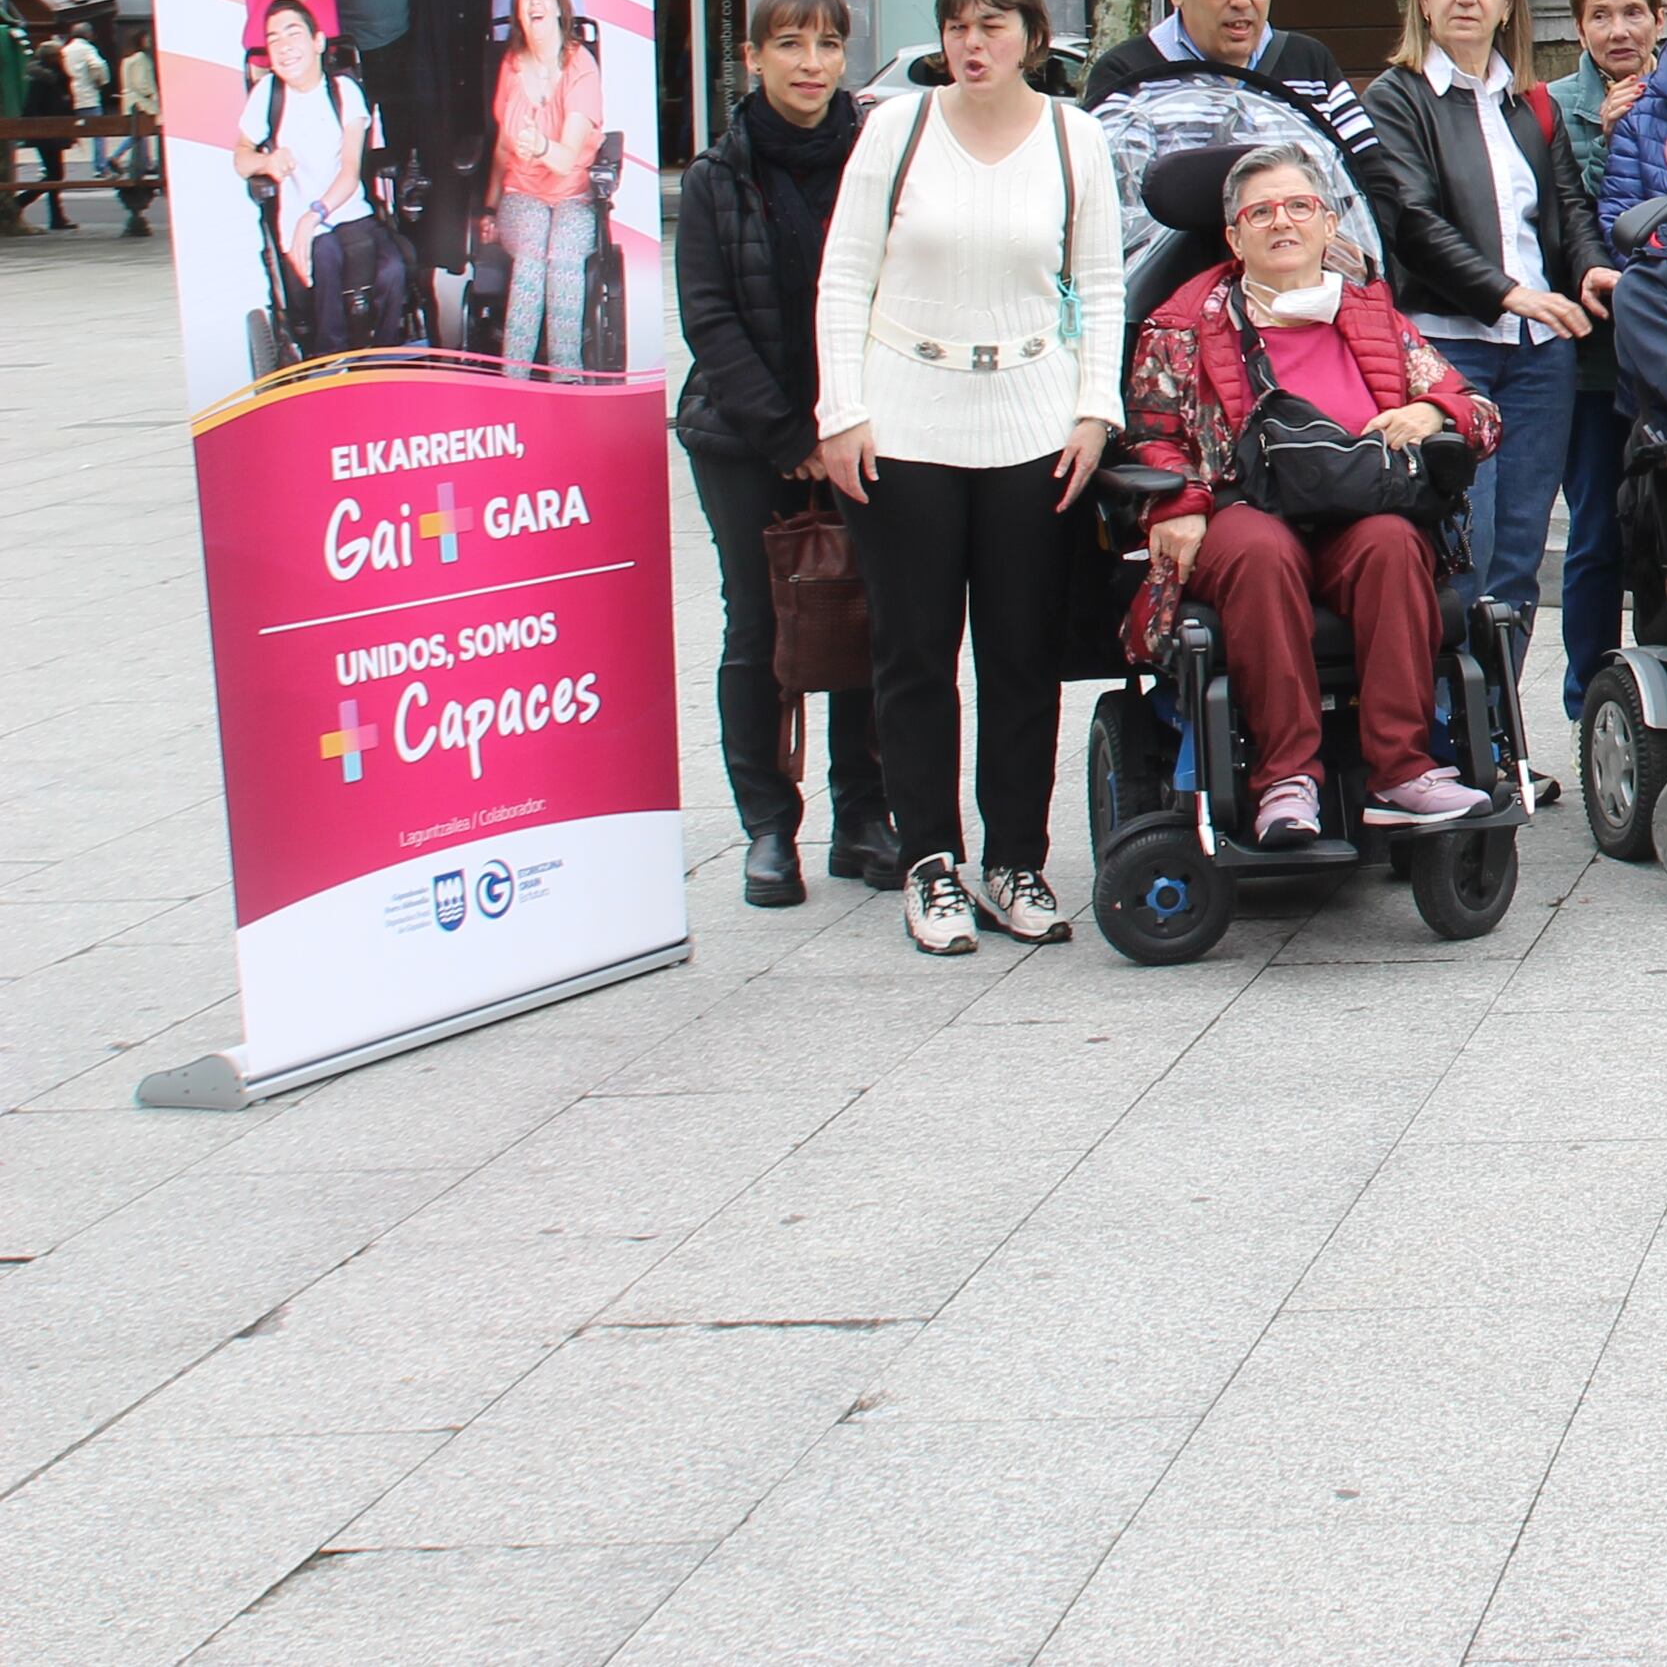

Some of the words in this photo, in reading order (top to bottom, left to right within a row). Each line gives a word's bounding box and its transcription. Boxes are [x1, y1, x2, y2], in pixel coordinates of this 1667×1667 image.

[331, 422, 525, 481] ELKARREKIN,
[323, 497, 413, 582] Gai
[483, 485, 591, 541] GARA
[335, 640, 455, 686] UNIDOS,
[458, 611, 558, 662] SOMOS
[394, 672, 601, 780] Capaces
